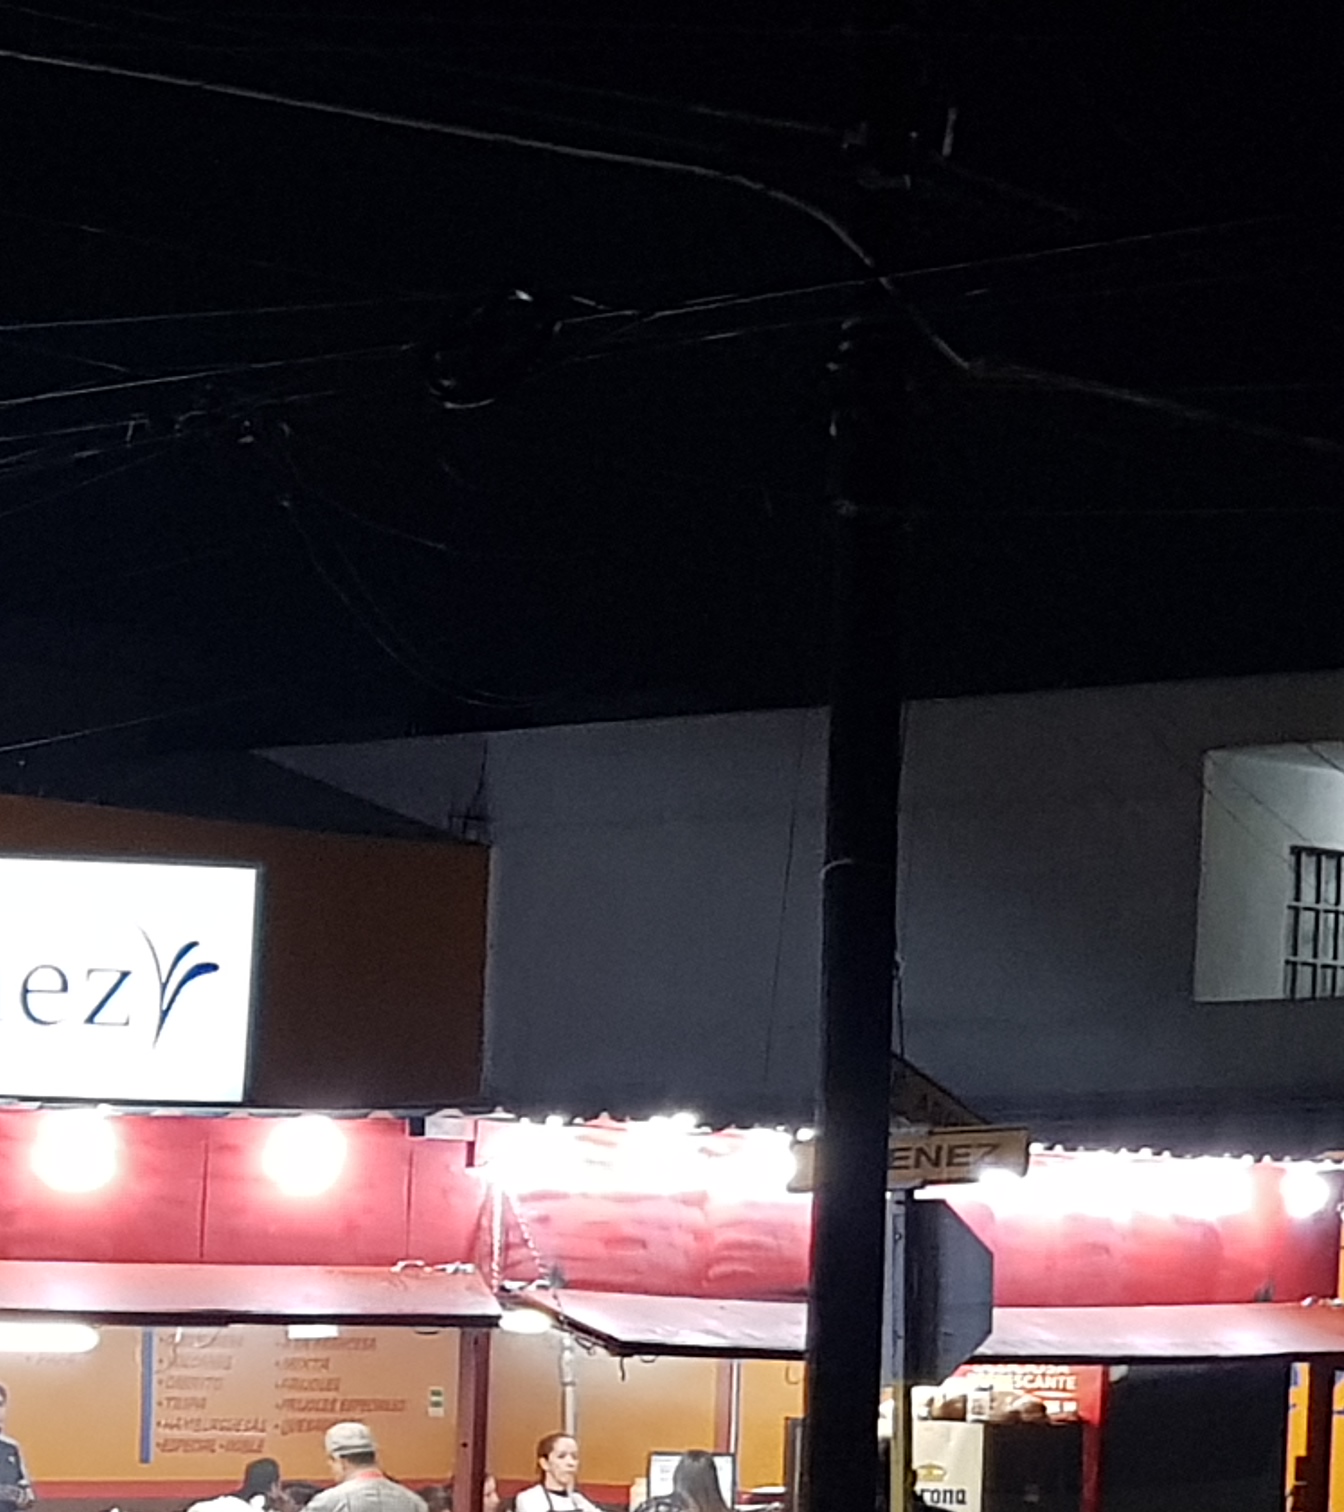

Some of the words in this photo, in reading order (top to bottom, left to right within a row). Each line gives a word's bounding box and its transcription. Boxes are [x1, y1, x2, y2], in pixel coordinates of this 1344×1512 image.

[889, 1143, 1001, 1170] ENEZ
[1013, 1374, 1078, 1390] SCANTE
[920, 1488, 966, 1505] rona
